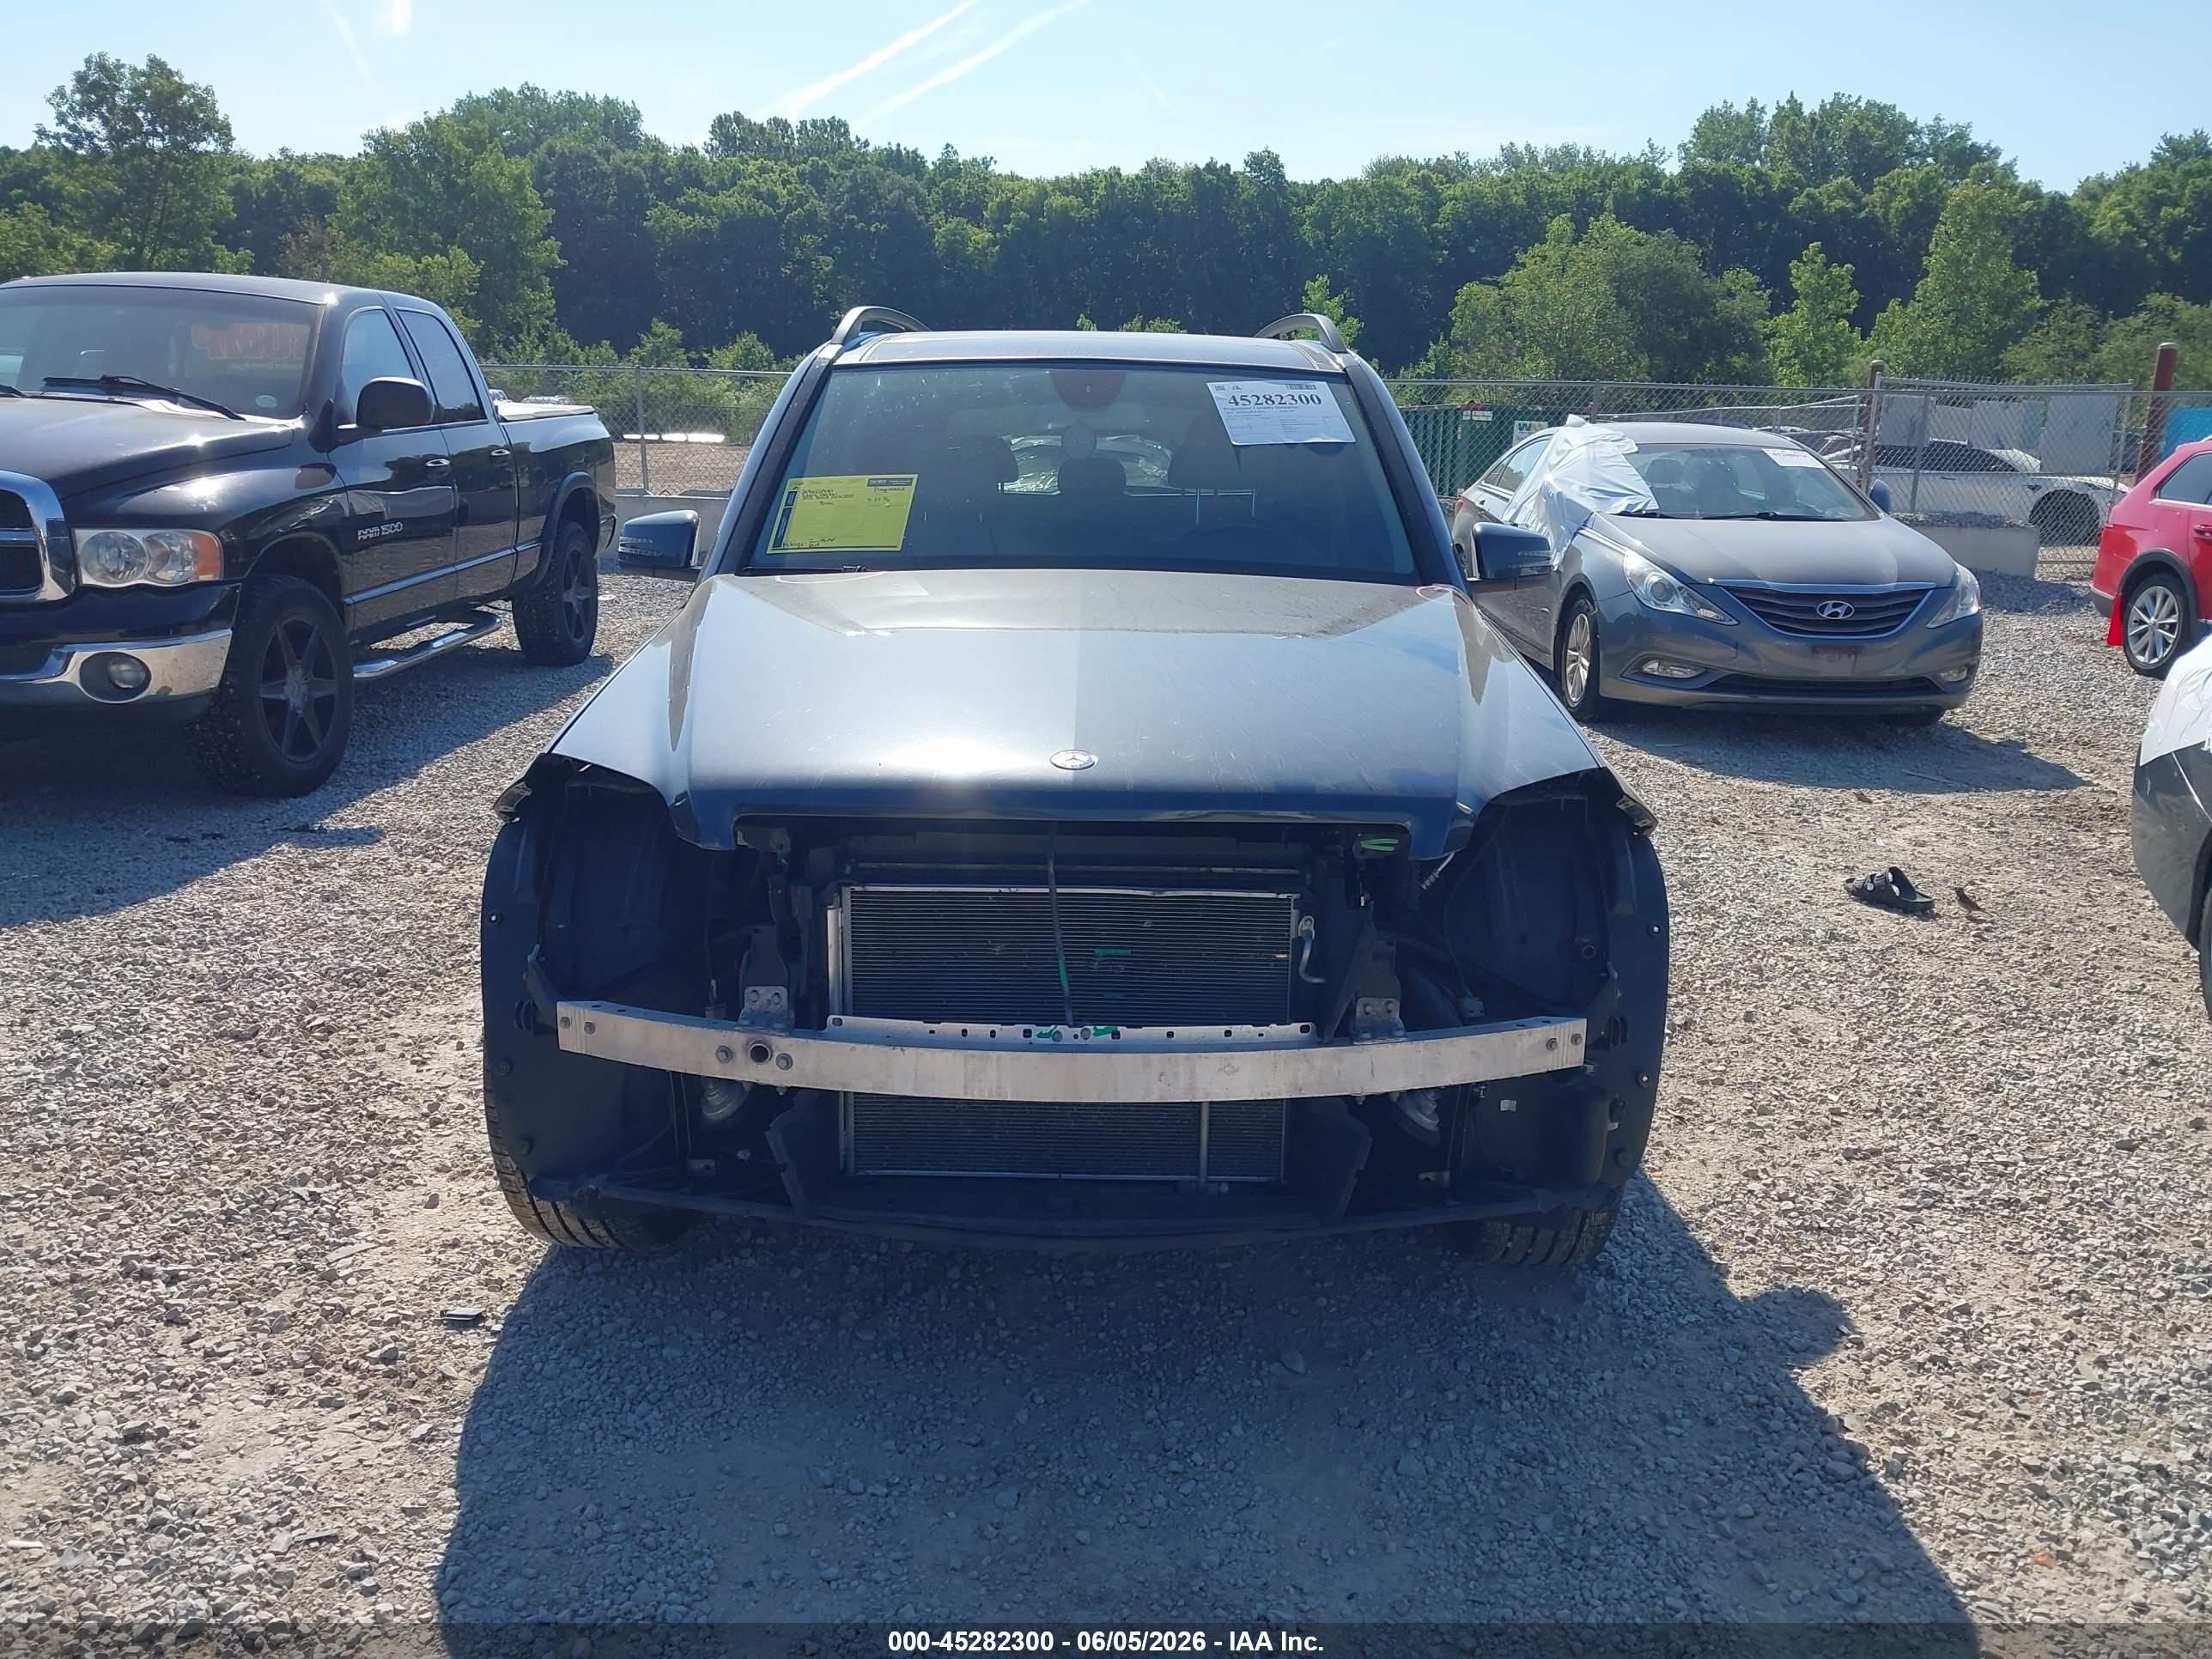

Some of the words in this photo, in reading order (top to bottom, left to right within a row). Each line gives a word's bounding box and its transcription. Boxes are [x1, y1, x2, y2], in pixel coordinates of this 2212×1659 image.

[1228, 393, 1322, 406] 45282300
[357, 526, 380, 541] RAM
[380, 521, 404, 536] 1500
